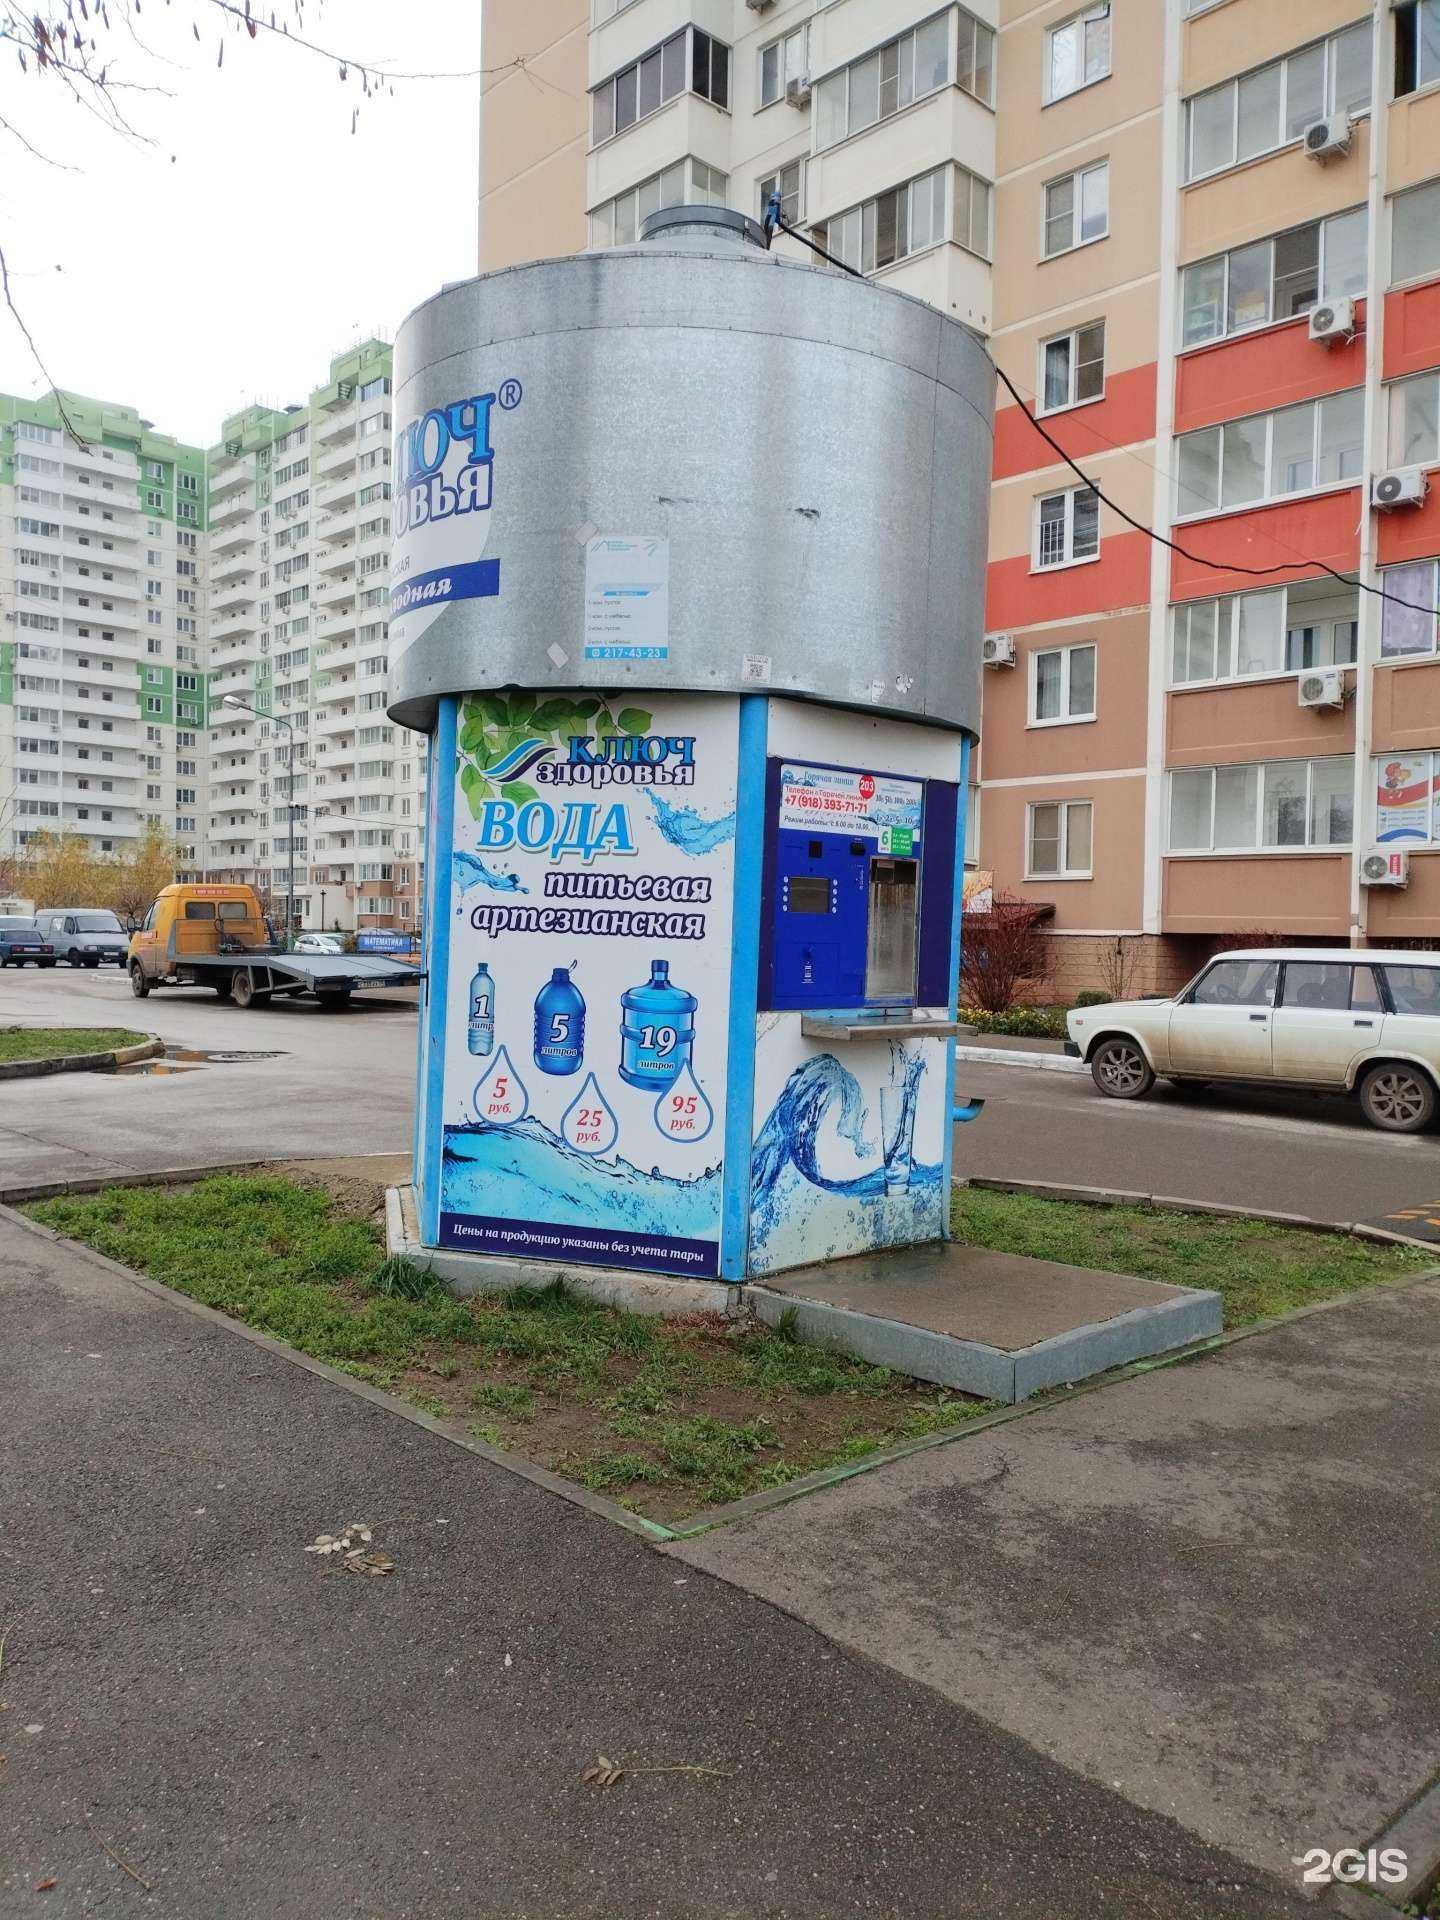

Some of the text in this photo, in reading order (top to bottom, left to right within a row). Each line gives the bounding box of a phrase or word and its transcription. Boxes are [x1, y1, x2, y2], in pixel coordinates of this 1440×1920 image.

[860, 781, 875, 793] 203
[476, 800, 638, 865] ВОДА
[545, 872, 711, 903] питьевая
[471, 905, 706, 939] артезианская
[473, 994, 490, 1019] 1
[549, 1013, 571, 1044] 5
[639, 1025, 678, 1057] 19
[541, 1046, 578, 1057] литров
[639, 1060, 675, 1070] литров
[492, 1078, 508, 1099] 5
[488, 1101, 512, 1114] руб.
[671, 1096, 698, 1114] 95
[576, 1109, 603, 1127] 25
[670, 1117, 696, 1131] руб.
[576, 1131, 601, 1144] руб.
[453, 1224, 704, 1263] Цены на продукцию указаны без учета тары
